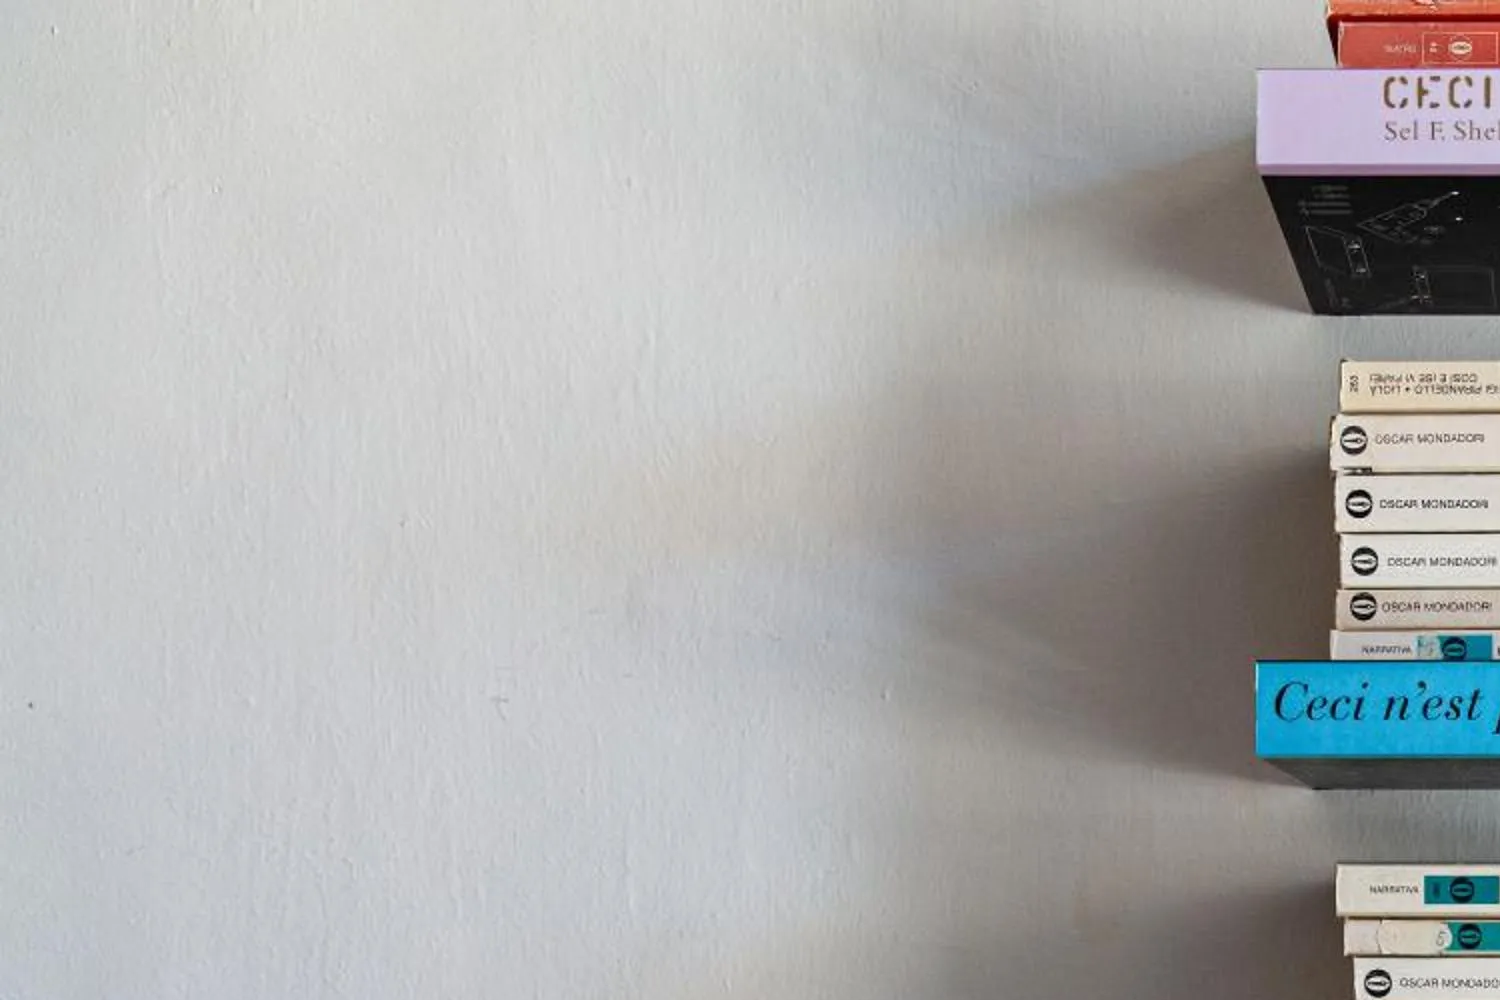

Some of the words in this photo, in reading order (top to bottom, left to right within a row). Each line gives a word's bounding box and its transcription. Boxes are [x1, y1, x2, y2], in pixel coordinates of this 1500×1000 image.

[1383, 75, 1492, 109] CECI
[1384, 119, 1419, 141] Sel
[1430, 119, 1445, 141] F.
[1375, 433, 1414, 445] OSCAR
[1417, 433, 1485, 445] MONDADORI
[1379, 499, 1417, 509] OSCAR
[1421, 499, 1489, 509] MONDADORI
[1387, 557, 1426, 567] OSCAR
[1430, 557, 1497, 567] MONDADORI
[1381, 601, 1420, 612] OSCAR
[1424, 601, 1492, 612] MONDADORI
[1274, 681, 1370, 722] Ceci
[1384, 681, 1481, 722] n'est
[1400, 978, 1439, 989] OSCAR
